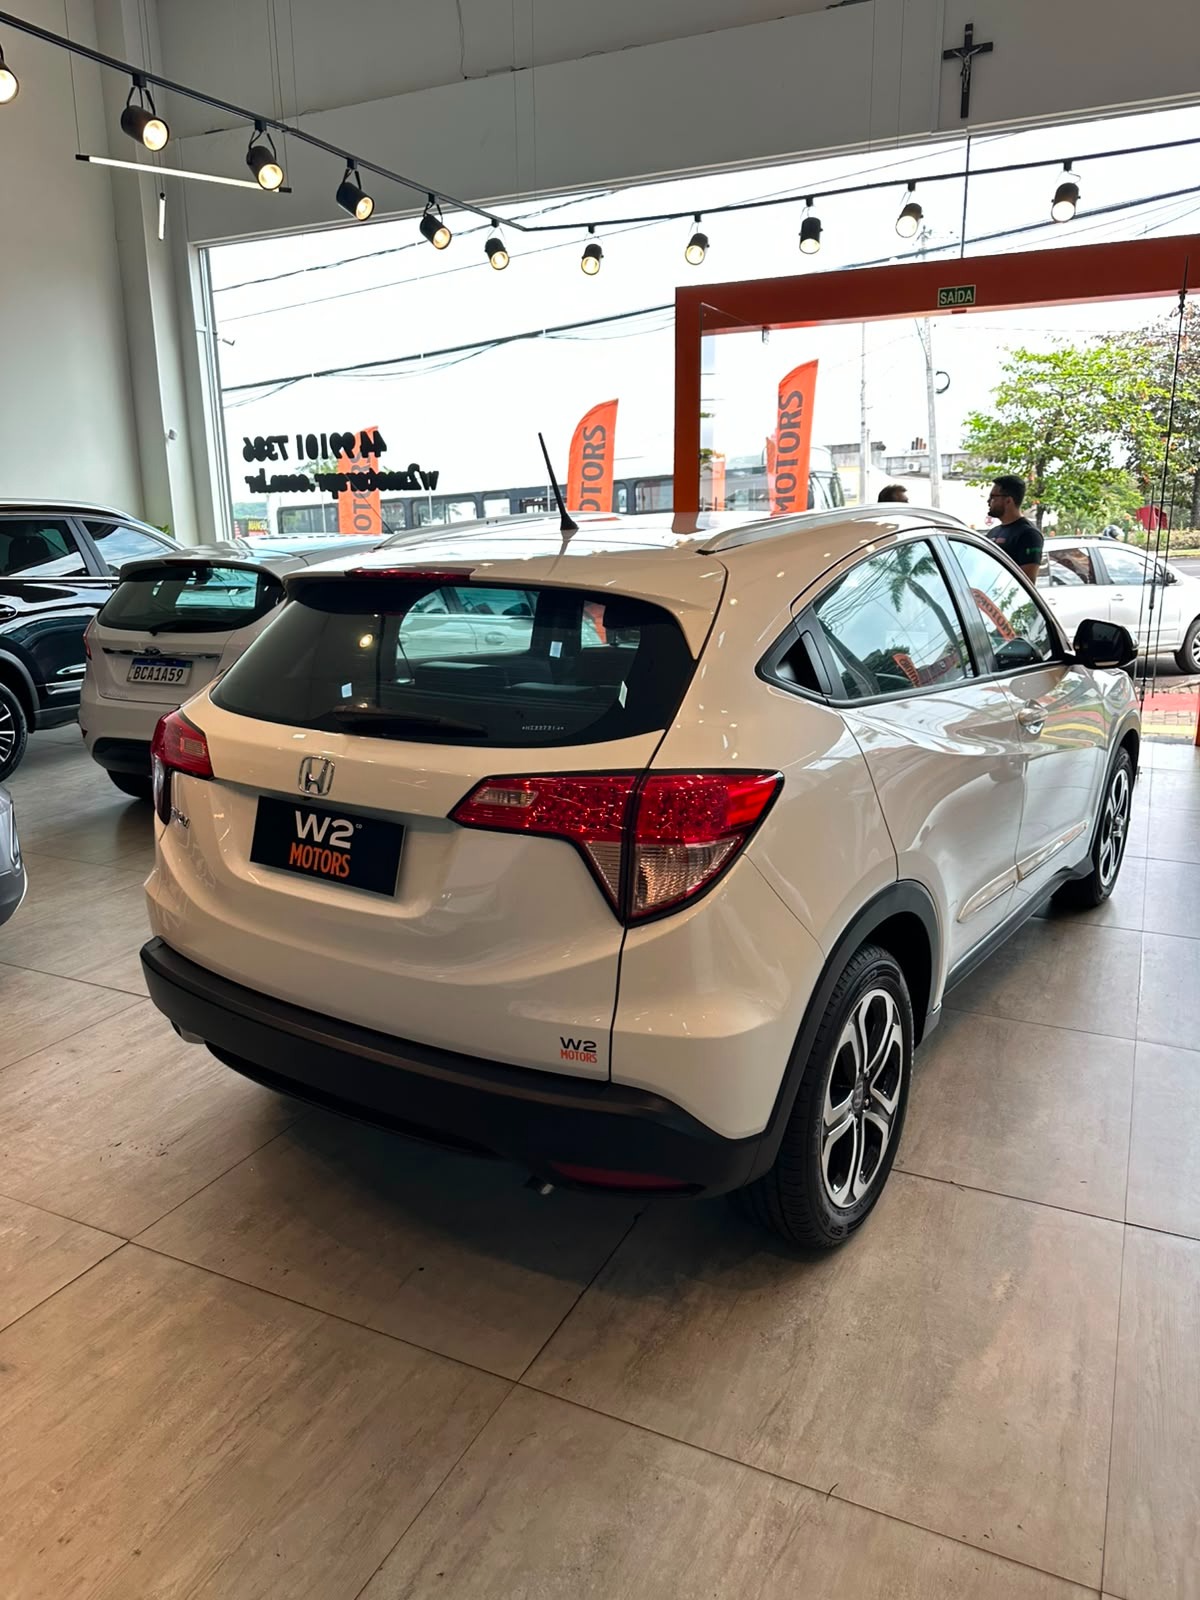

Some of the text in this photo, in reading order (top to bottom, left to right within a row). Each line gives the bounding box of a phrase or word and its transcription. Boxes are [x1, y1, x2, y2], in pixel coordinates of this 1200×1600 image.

[940, 287, 973, 305] SAÍDA
[774, 390, 804, 513] MOTORS
[133, 666, 184, 683] BCA1A59
[295, 810, 354, 849] W2
[289, 842, 351, 878] MOTORS
[560, 1036, 597, 1053] W2
[560, 1049, 598, 1064] MOTORS
